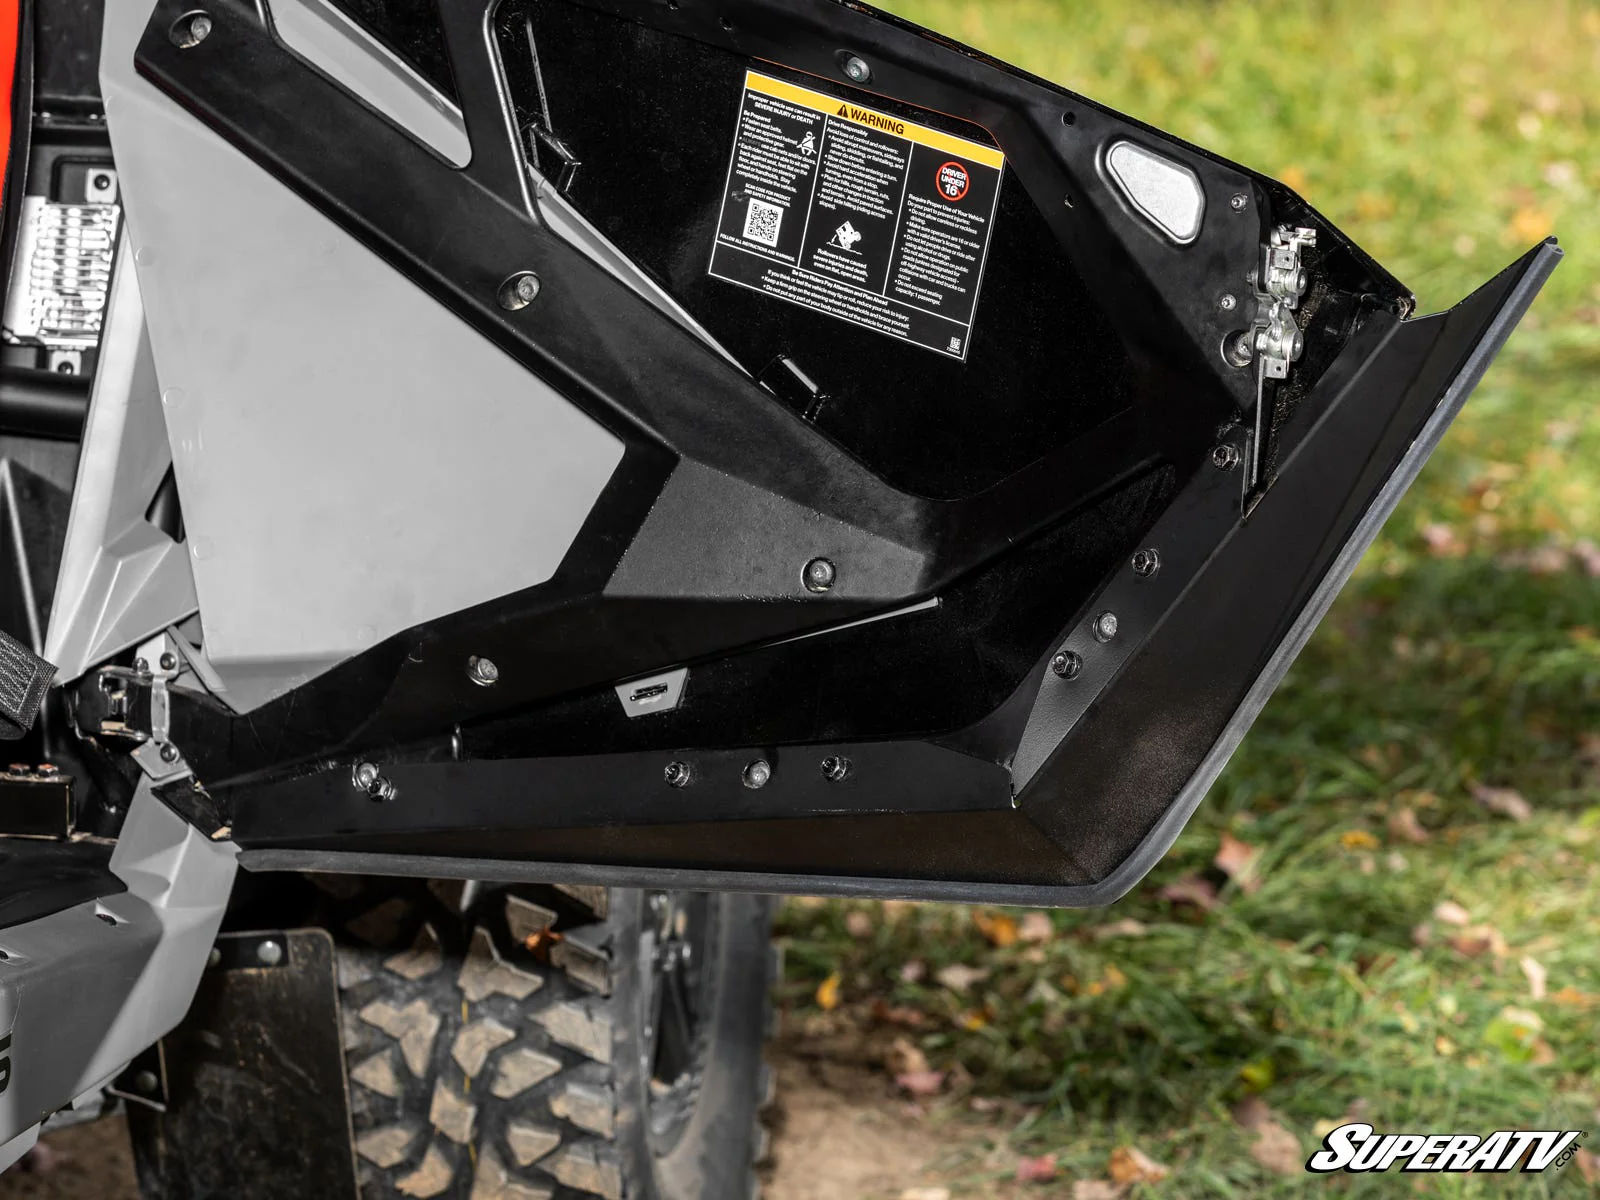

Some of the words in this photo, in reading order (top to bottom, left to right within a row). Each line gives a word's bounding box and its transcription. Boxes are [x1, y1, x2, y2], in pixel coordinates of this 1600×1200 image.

[750, 112, 771, 123] Prepared
[755, 102, 773, 112] SEVERE
[773, 108, 791, 117] INJURY
[796, 115, 813, 125] DEATH
[851, 109, 904, 134] WARNING
[828, 119, 840, 127] Drive
[840, 123, 868, 137] Responsibly
[941, 175, 964, 188] UNDER
[942, 167, 966, 180] DRIVER
[945, 184, 958, 196] 16
[908, 194, 926, 204] Require
[926, 200, 942, 209] Proper
[942, 204, 952, 212] Use
[957, 209, 968, 217] Your
[968, 213, 984, 223] Vehicle
[937, 211, 954, 220] prevent
[813, 254, 828, 263] severe
[828, 259, 845, 268] injuries
[817, 248, 838, 259] Rollovers
[850, 260, 867, 269] caused
[798, 271, 809, 279] Sure
[809, 275, 824, 284] Riders
[823, 280, 833, 288] Pay
[833, 283, 854, 294] Attention
[862, 293, 873, 301] Plan
[873, 297, 888, 306] Ahead
